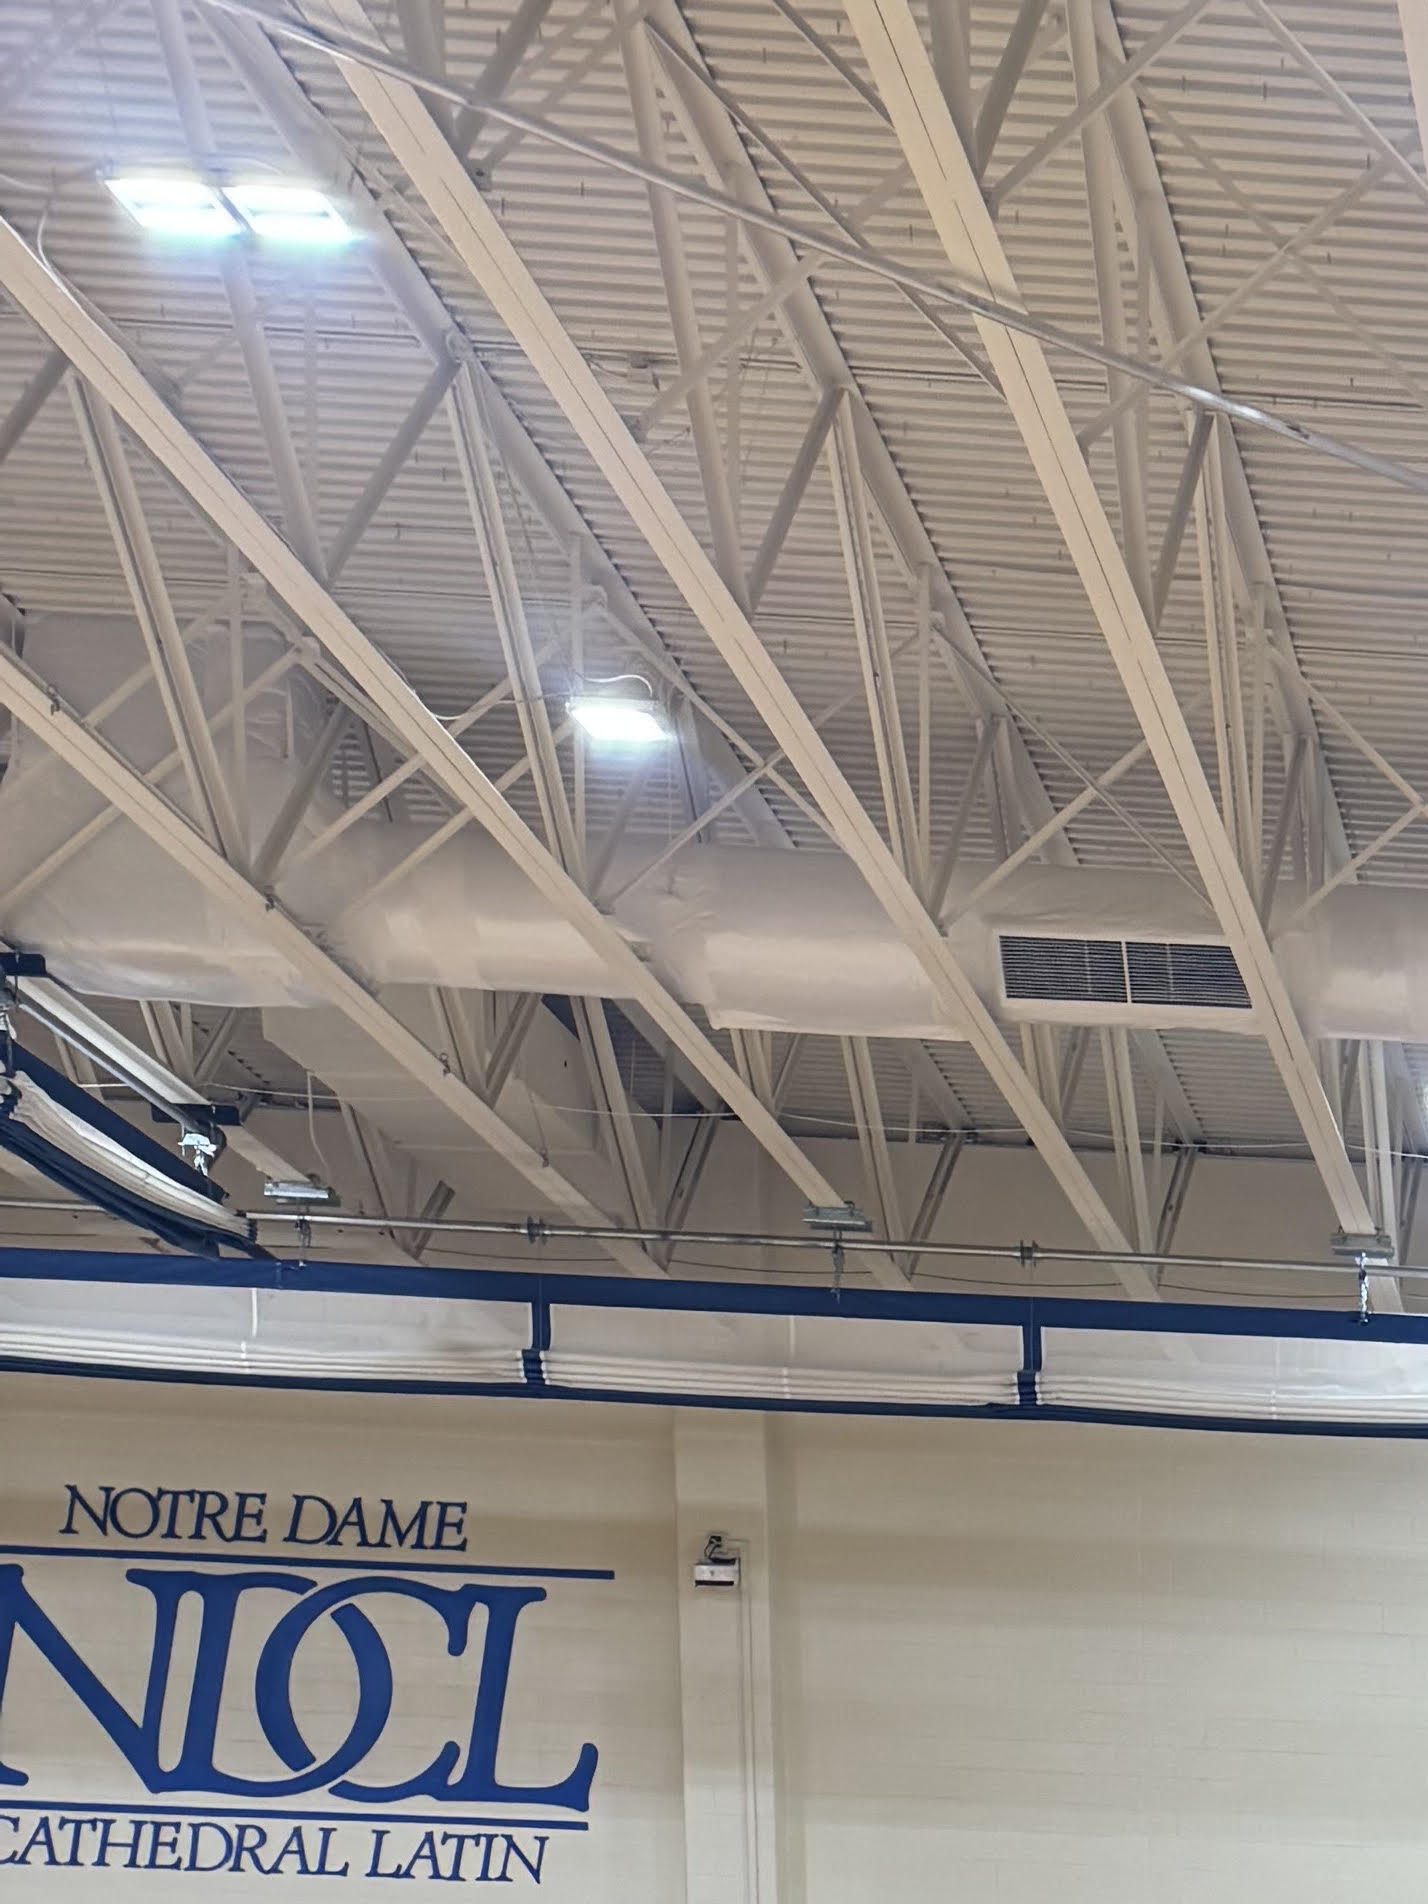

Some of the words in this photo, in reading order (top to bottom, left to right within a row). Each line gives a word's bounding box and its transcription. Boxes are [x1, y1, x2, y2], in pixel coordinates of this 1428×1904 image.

[59, 1484, 268, 1544] NOTRE
[282, 1495, 468, 1552] DAME
[365, 1830, 549, 1884] LATIN
